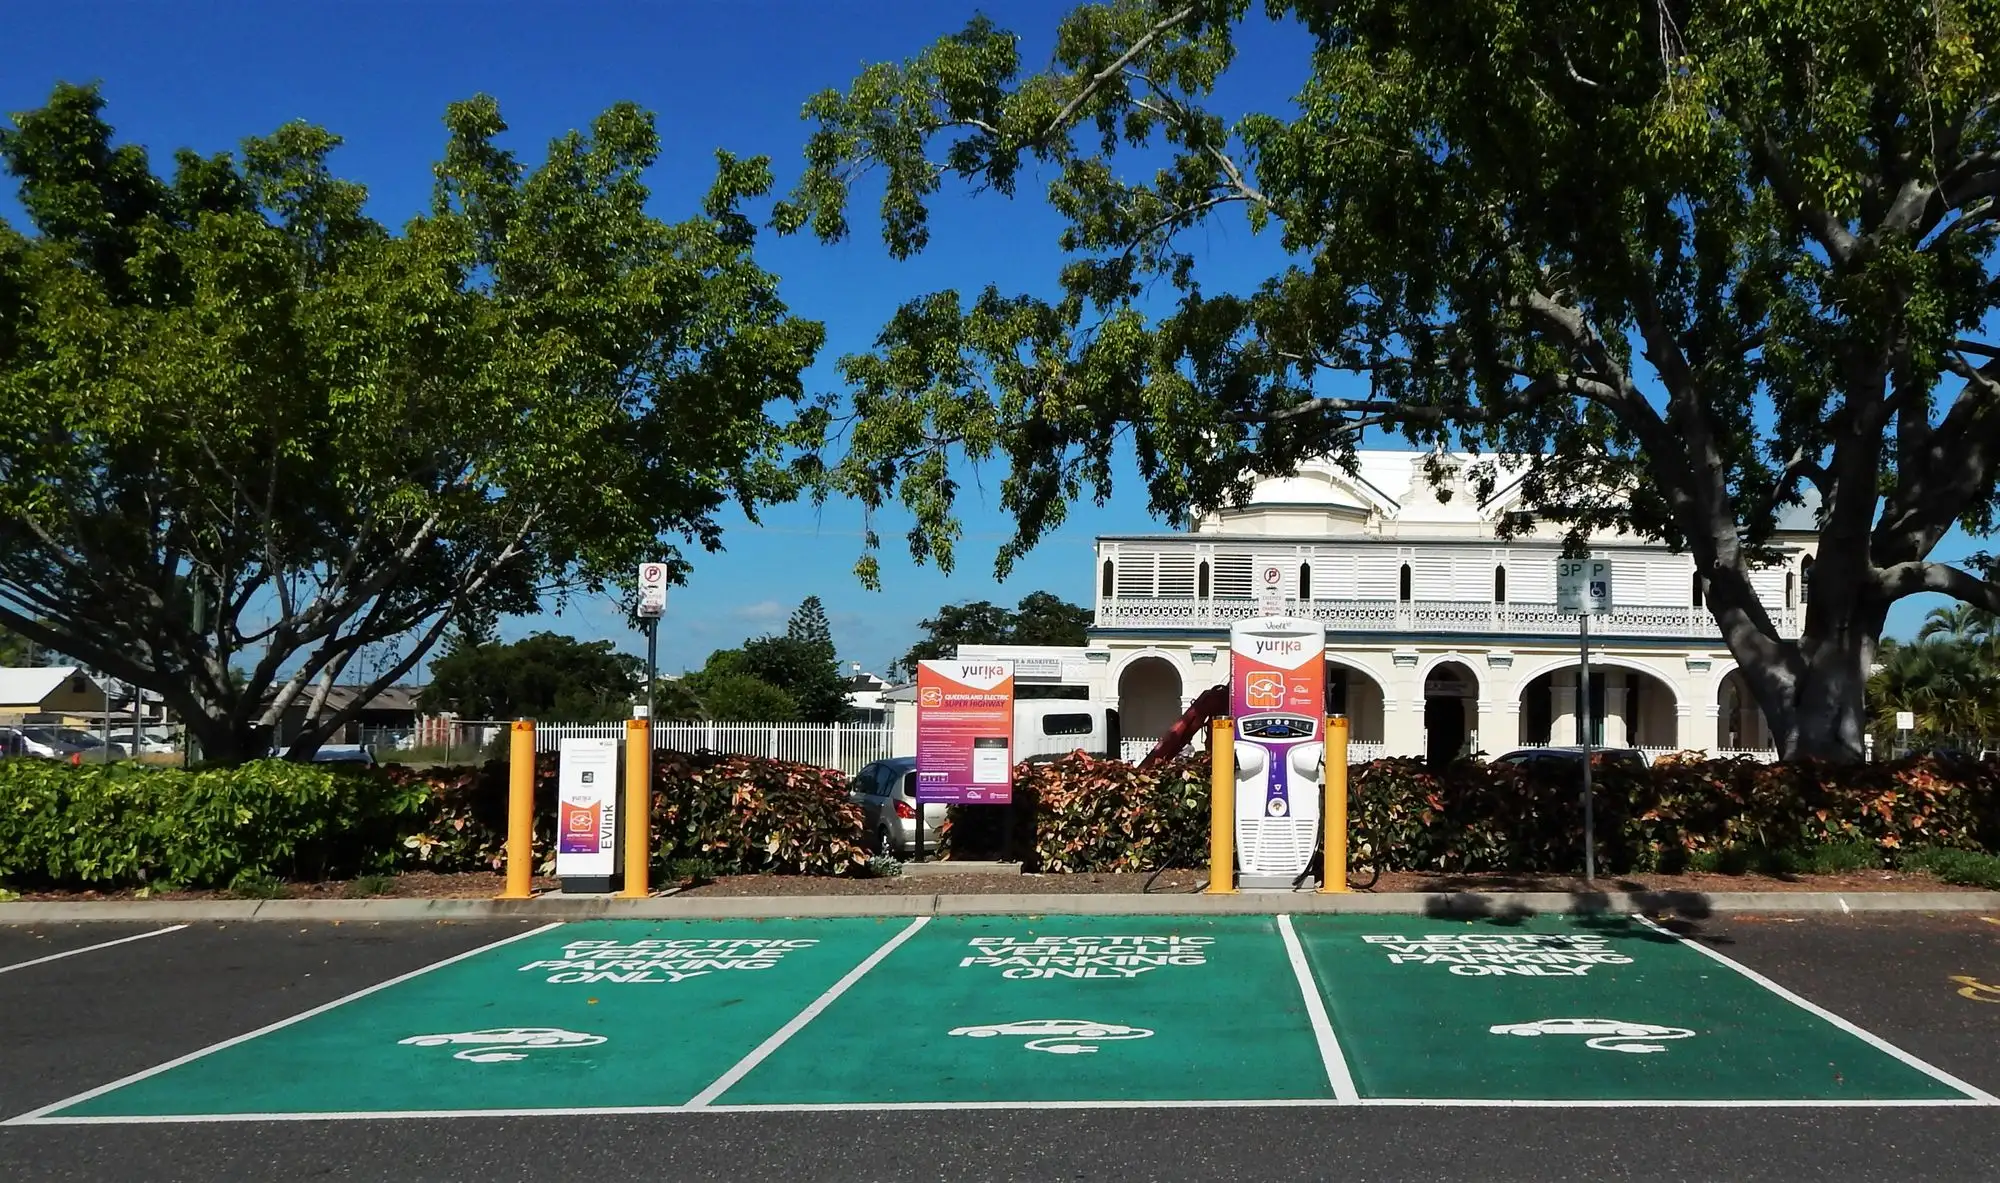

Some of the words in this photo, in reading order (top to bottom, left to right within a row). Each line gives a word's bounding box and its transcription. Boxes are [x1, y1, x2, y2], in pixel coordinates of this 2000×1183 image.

[1560, 563, 1582, 577] 3P
[1593, 563, 1604, 577] P
[1256, 640, 1302, 655] yurika
[961, 665, 1004, 680] yurika
[944, 700, 968, 708] SUPER
[969, 700, 1005, 708] HIGHWAY
[600, 804, 614, 849] EVlink
[561, 939, 821, 950] ELECTRIC
[967, 936, 1216, 946] ELECTRIC
[1361, 934, 1610, 944] ELECTRIC
[564, 948, 794, 960] VEHICLE
[978, 945, 1205, 956] VEHICLE
[1381, 943, 1617, 954] VEHICLE
[517, 959, 778, 972] PARKING
[959, 955, 1208, 968] PARKING
[1387, 953, 1635, 965] PARKING
[546, 970, 713, 984] ONLY
[1001, 966, 1157, 980] ONLY
[1449, 964, 1594, 977] ONLY
